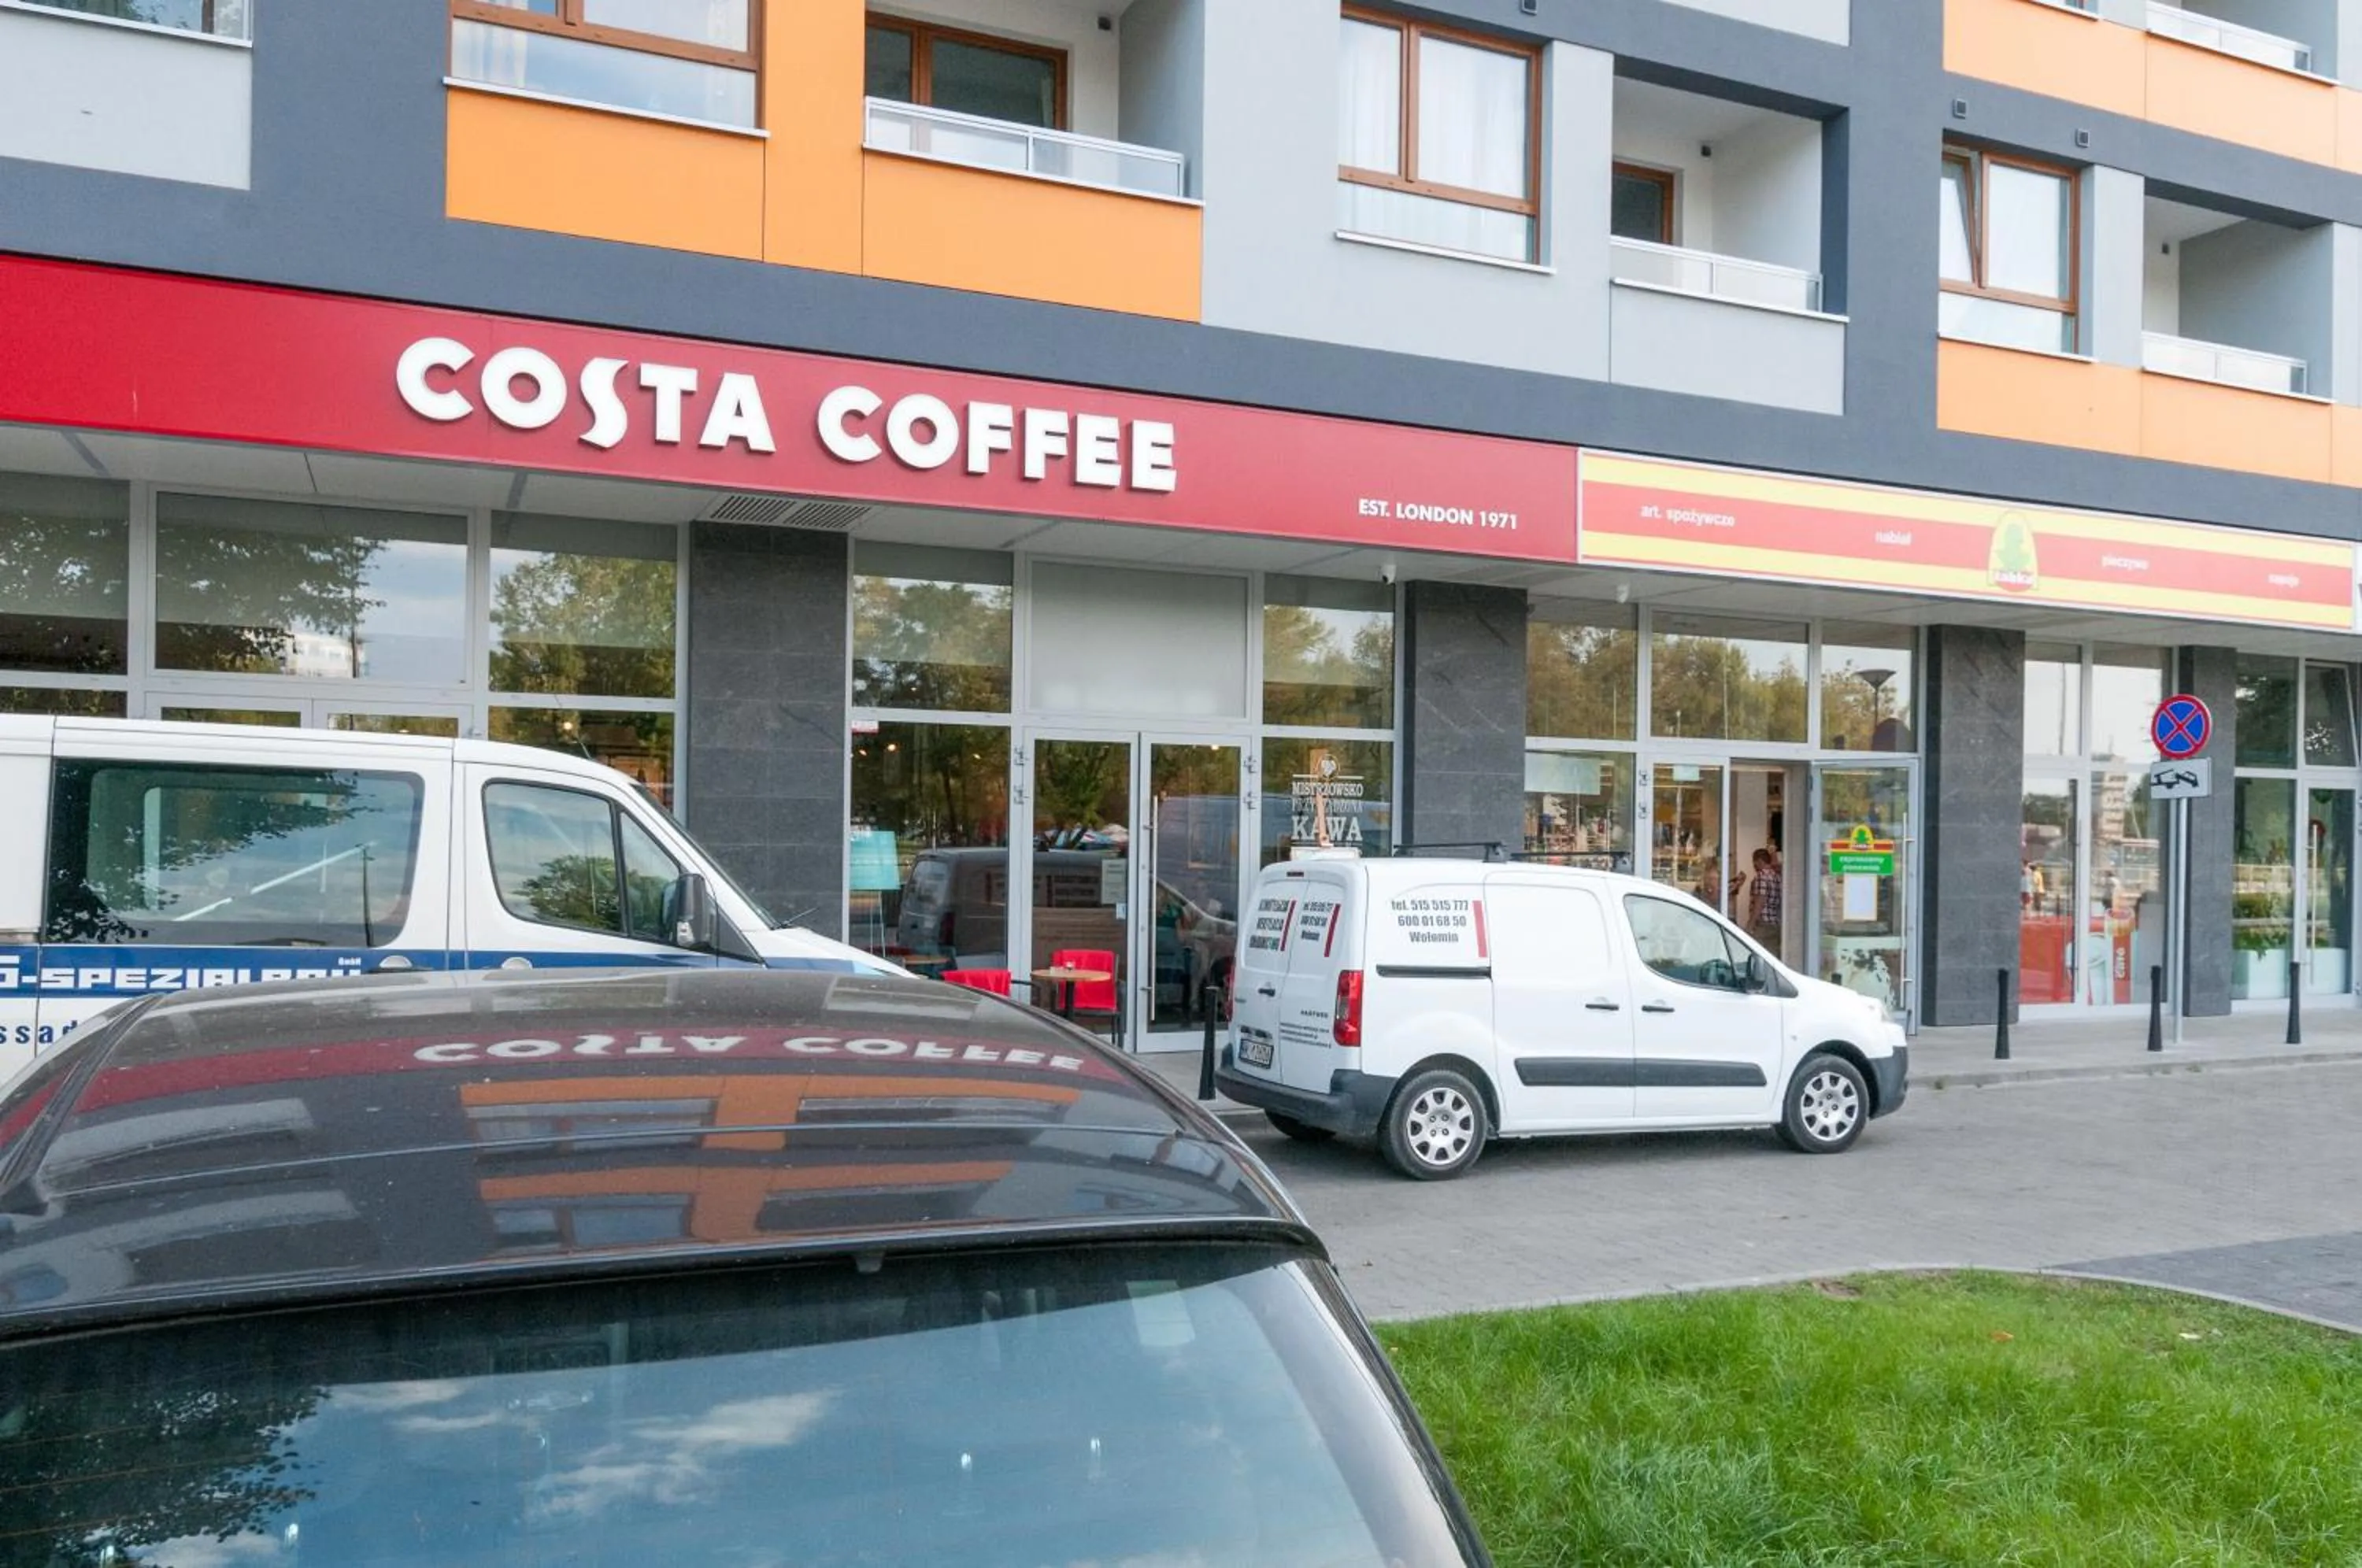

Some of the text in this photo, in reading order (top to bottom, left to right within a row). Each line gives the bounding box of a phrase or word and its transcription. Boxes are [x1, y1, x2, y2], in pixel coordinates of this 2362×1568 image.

[395, 337, 1177, 493] COSTA COFFEE
[1358, 498, 1518, 530] EST. LONDON 1971
[1641, 505, 1662, 519] art.
[1291, 815, 1363, 841] KAWA
[1410, 900, 1431, 911] 515
[1432, 900, 1451, 911] 515
[1453, 900, 1468, 911] 777
[1398, 915, 1420, 926] 600
[1452, 915, 1467, 926] 50
